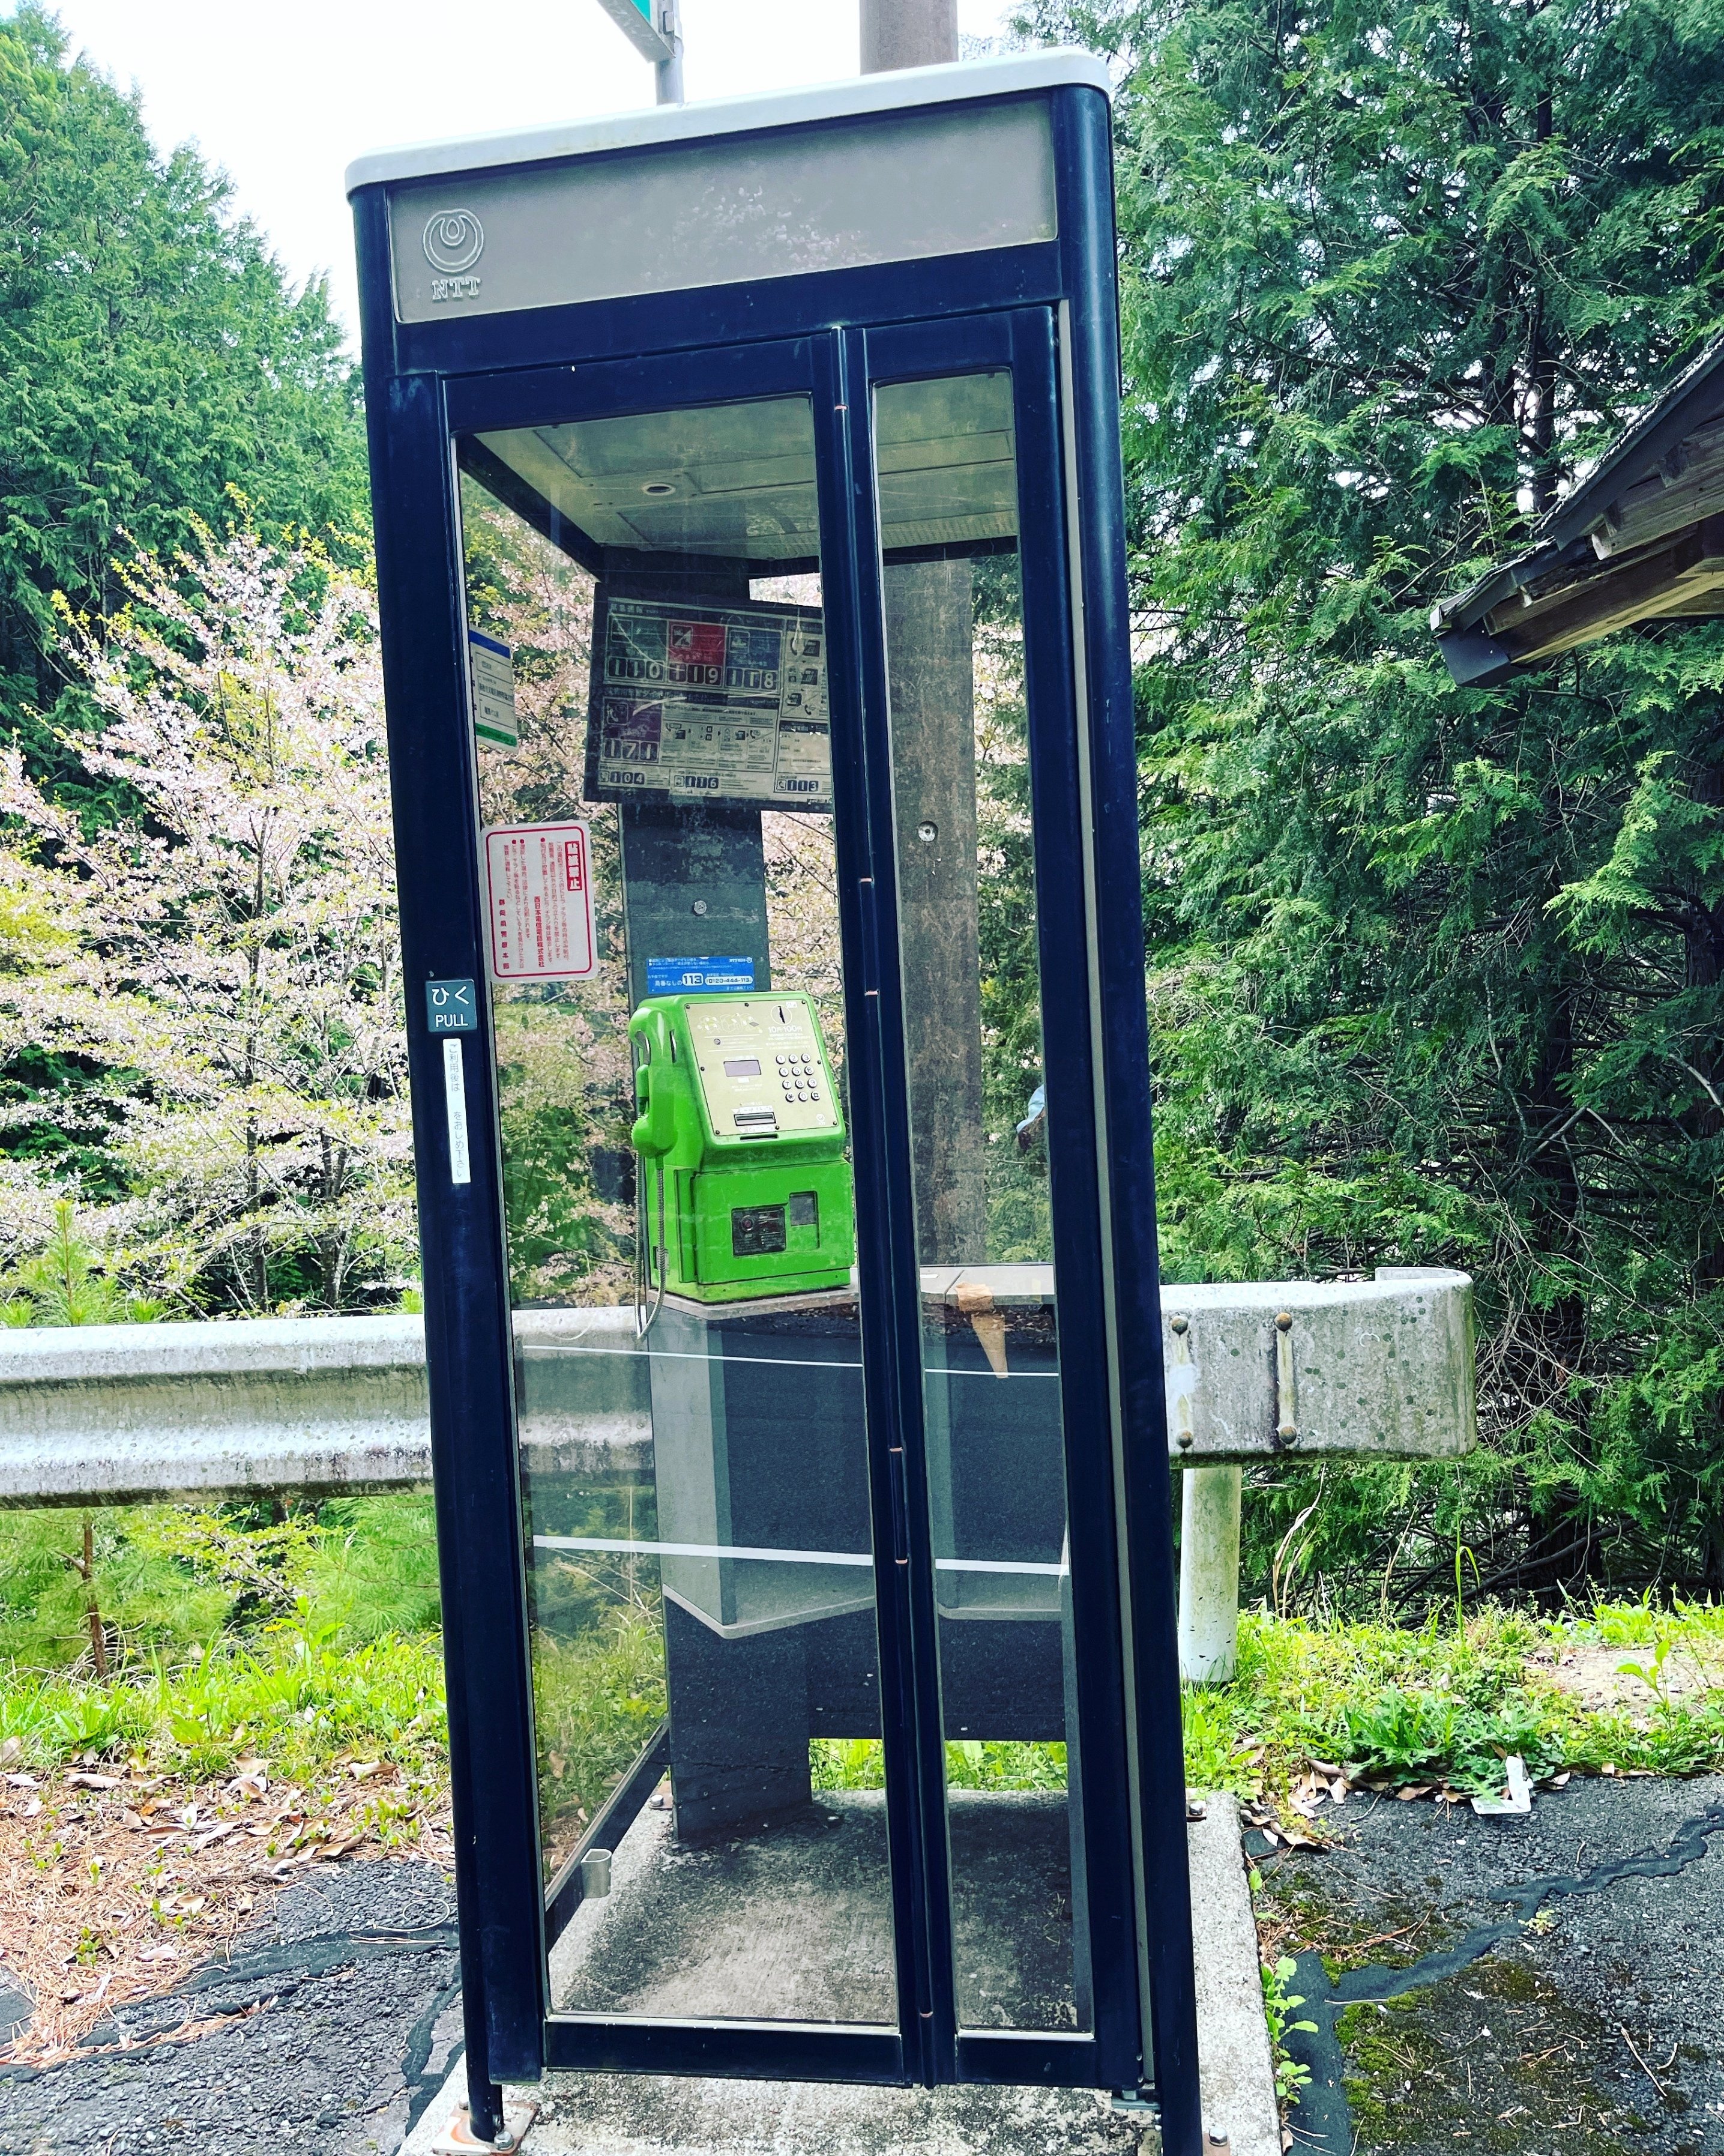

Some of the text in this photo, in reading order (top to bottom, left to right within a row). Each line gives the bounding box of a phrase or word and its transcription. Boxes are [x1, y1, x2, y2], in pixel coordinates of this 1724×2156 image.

[432, 276, 481, 300] NTT
[615, 659, 660, 679] 110
[675, 665, 719, 684] 119
[731, 669, 774, 689] 118
[610, 739, 651, 759] 171
[613, 772, 644, 784] 104
[688, 778, 717, 788] 116
[790, 781, 816, 791] 113
[683, 975, 702, 985] 113
[432, 985, 469, 1006] ひく
[435, 1014, 468, 1028] PULL
[450, 1043, 460, 1092] ご利用後は
